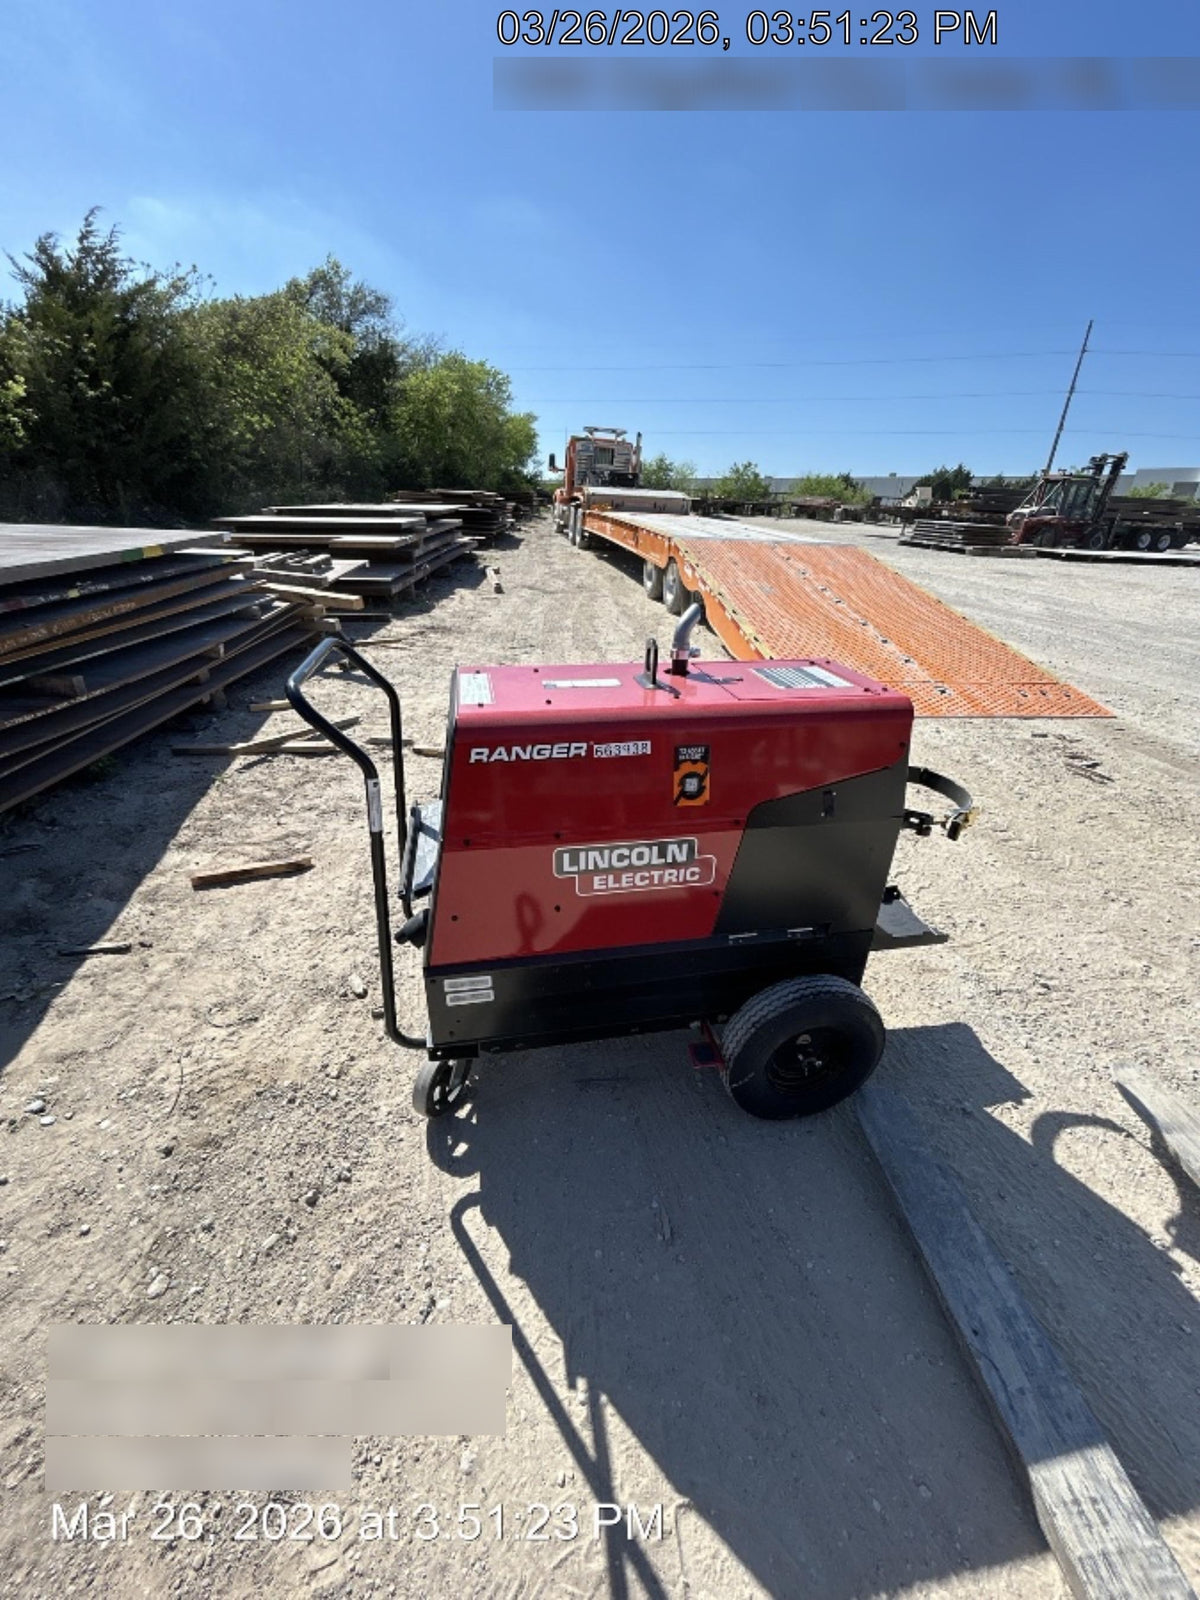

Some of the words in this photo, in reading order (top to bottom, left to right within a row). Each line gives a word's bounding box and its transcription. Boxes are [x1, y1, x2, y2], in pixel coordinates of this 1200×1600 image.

[469, 742, 588, 764] RANGER
[562, 842, 688, 872] LINCOLN
[592, 866, 701, 891] ELECTRIC
